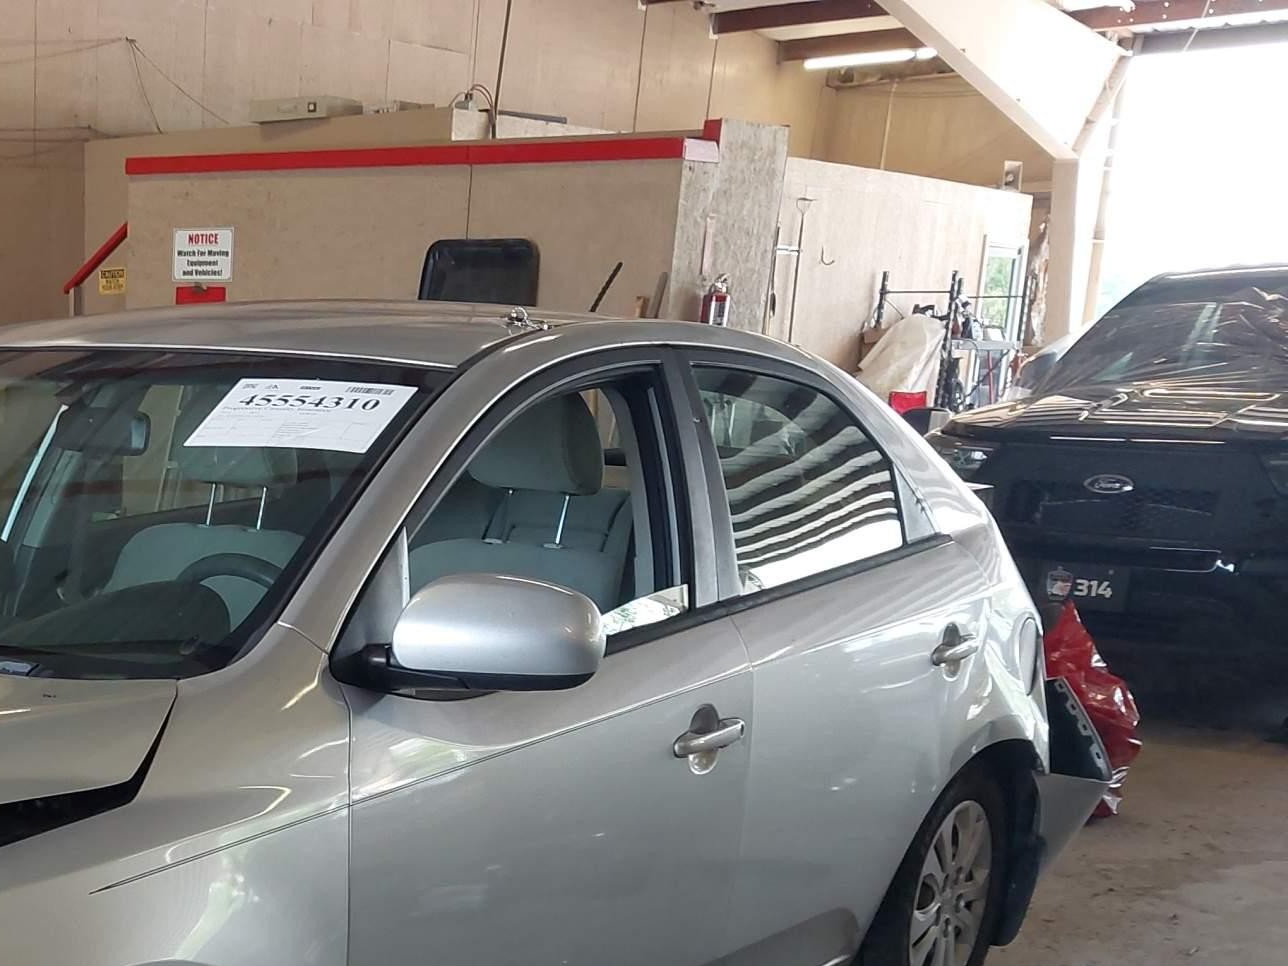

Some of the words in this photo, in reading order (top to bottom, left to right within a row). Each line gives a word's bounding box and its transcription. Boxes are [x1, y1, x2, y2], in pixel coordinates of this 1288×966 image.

[188, 233, 219, 245] NOTICE
[207, 250, 230, 258] Moving
[186, 259, 219, 268] Equipment
[182, 269, 194, 277] and
[194, 268, 223, 277] Vehicles!
[239, 394, 381, 411] 45554310
[1073, 579, 1113, 598] 314
